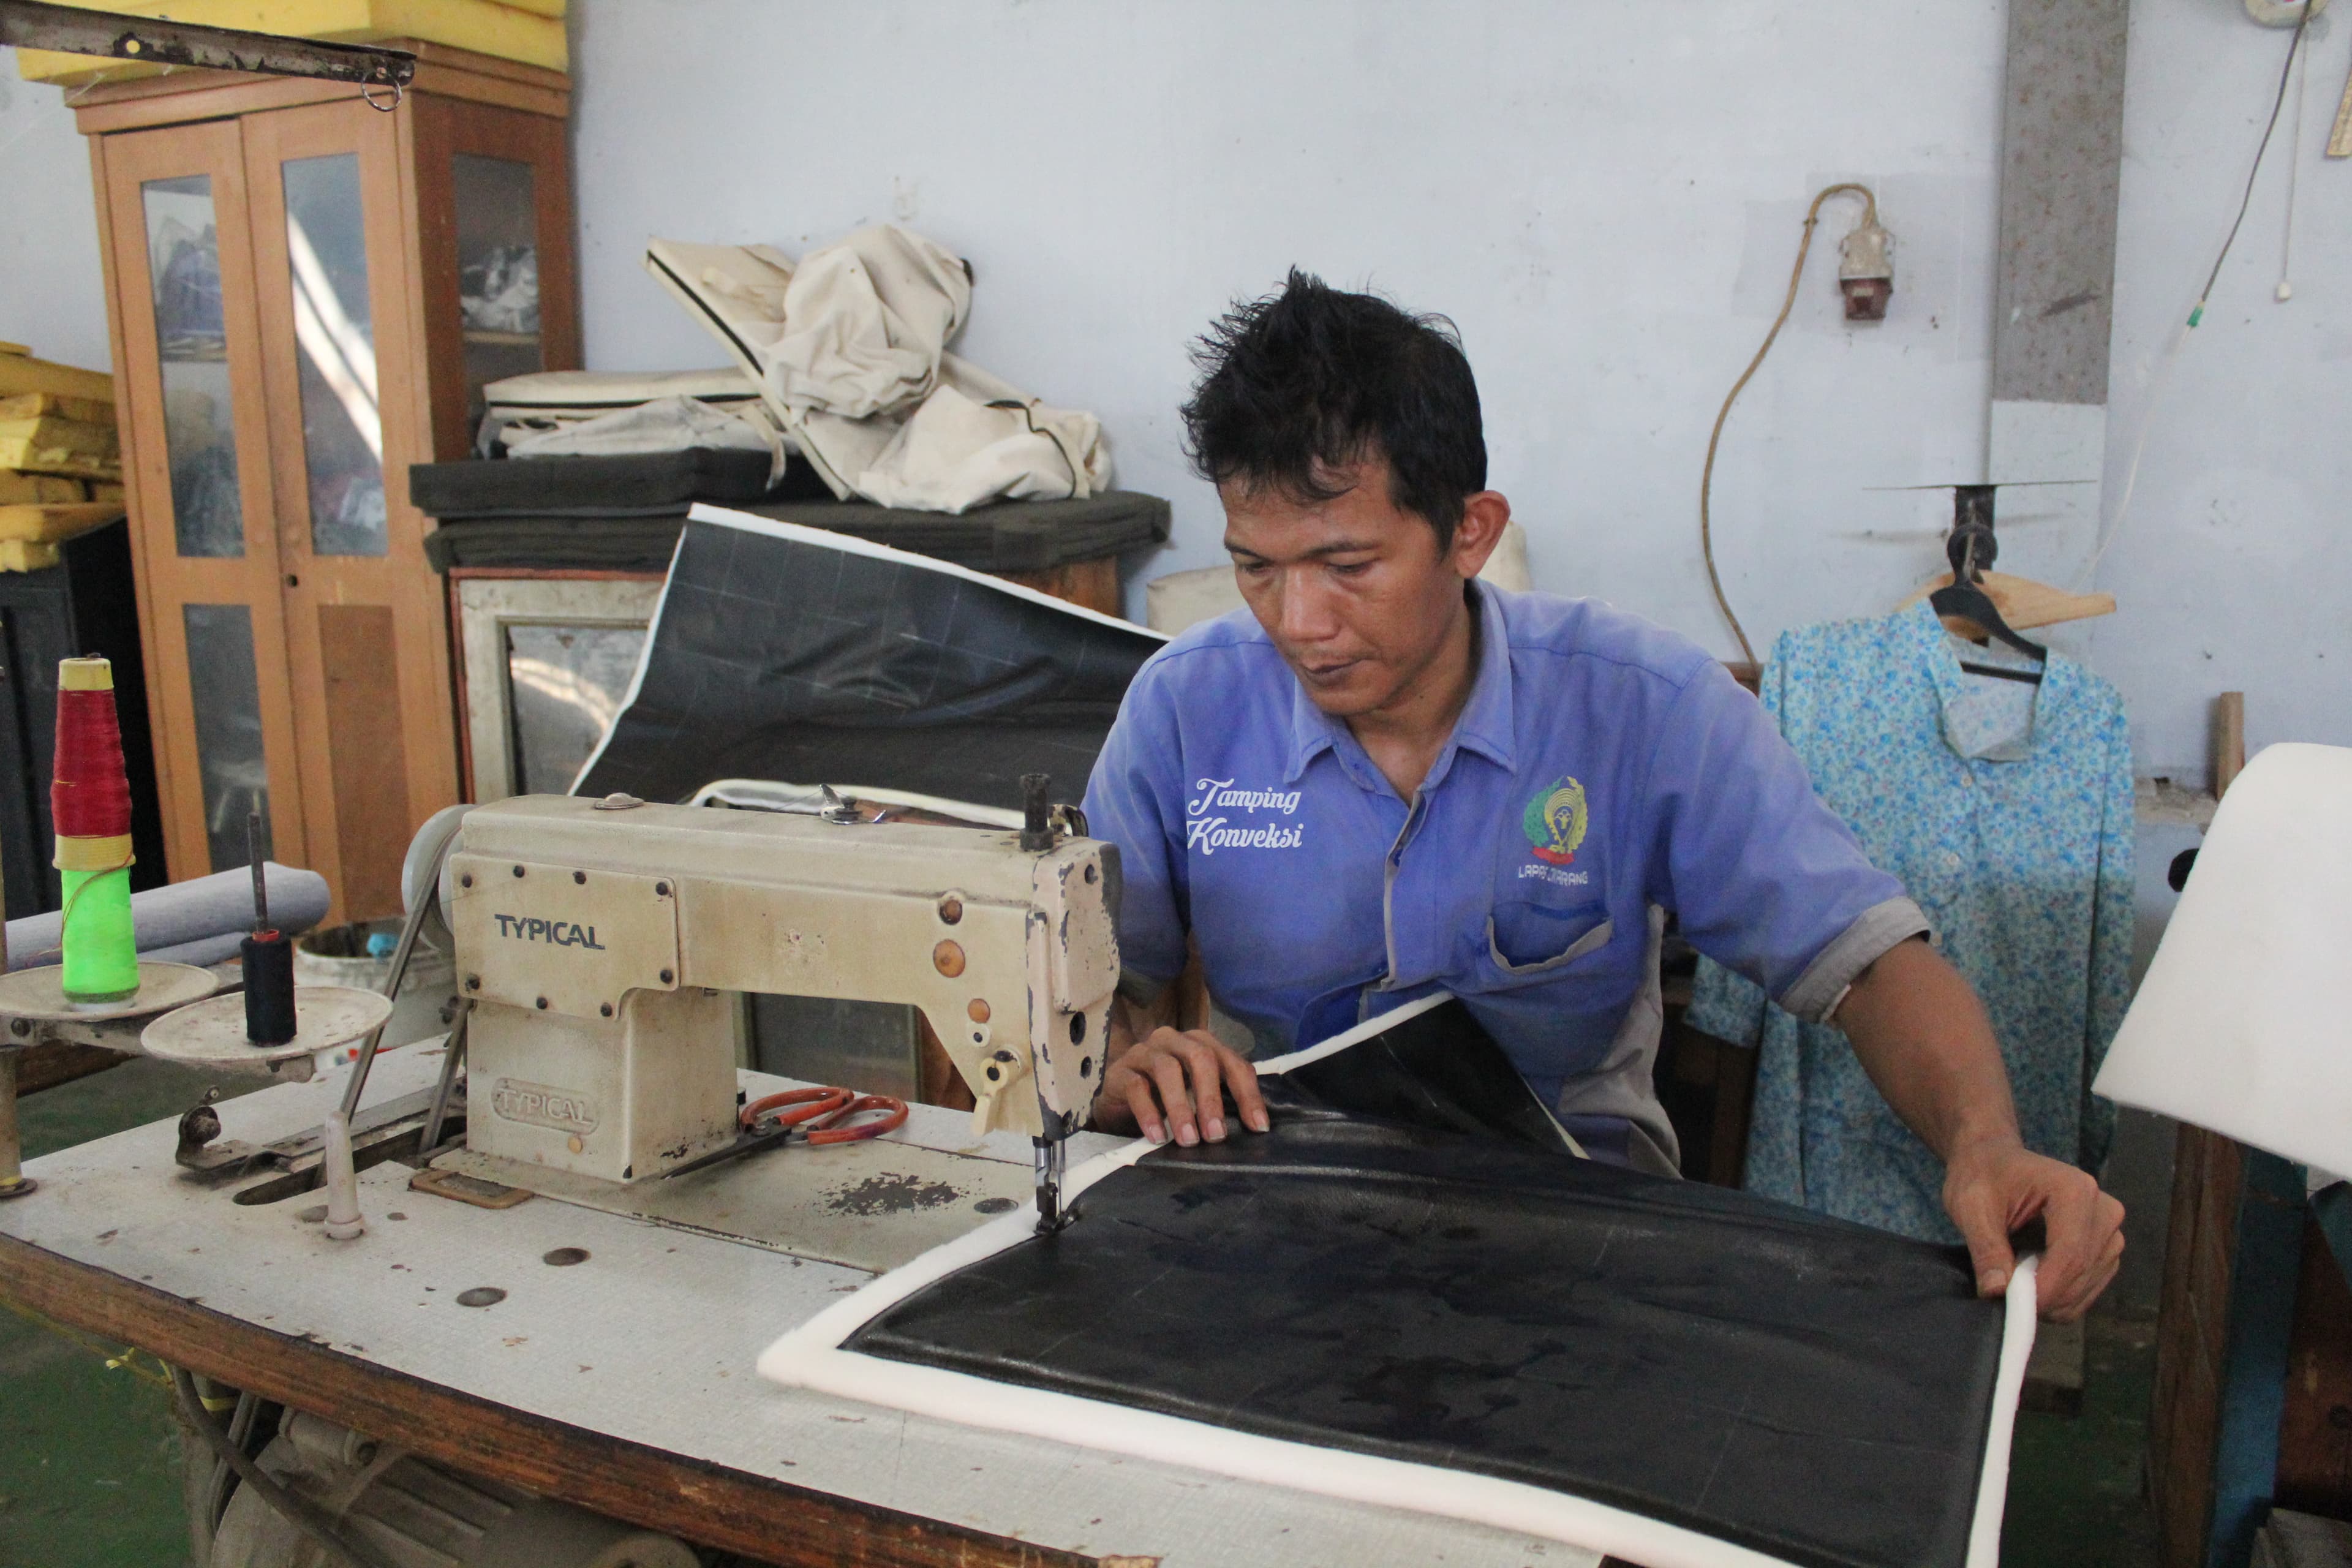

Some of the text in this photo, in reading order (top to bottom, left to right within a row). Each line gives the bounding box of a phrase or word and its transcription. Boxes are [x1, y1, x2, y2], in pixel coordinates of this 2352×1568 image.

[1188, 778, 1302, 816] Tamping
[1186, 817, 1304, 855] Konveksi
[494, 914, 606, 950] TYPICAL
[498, 1087, 593, 1125] TYPICAL
